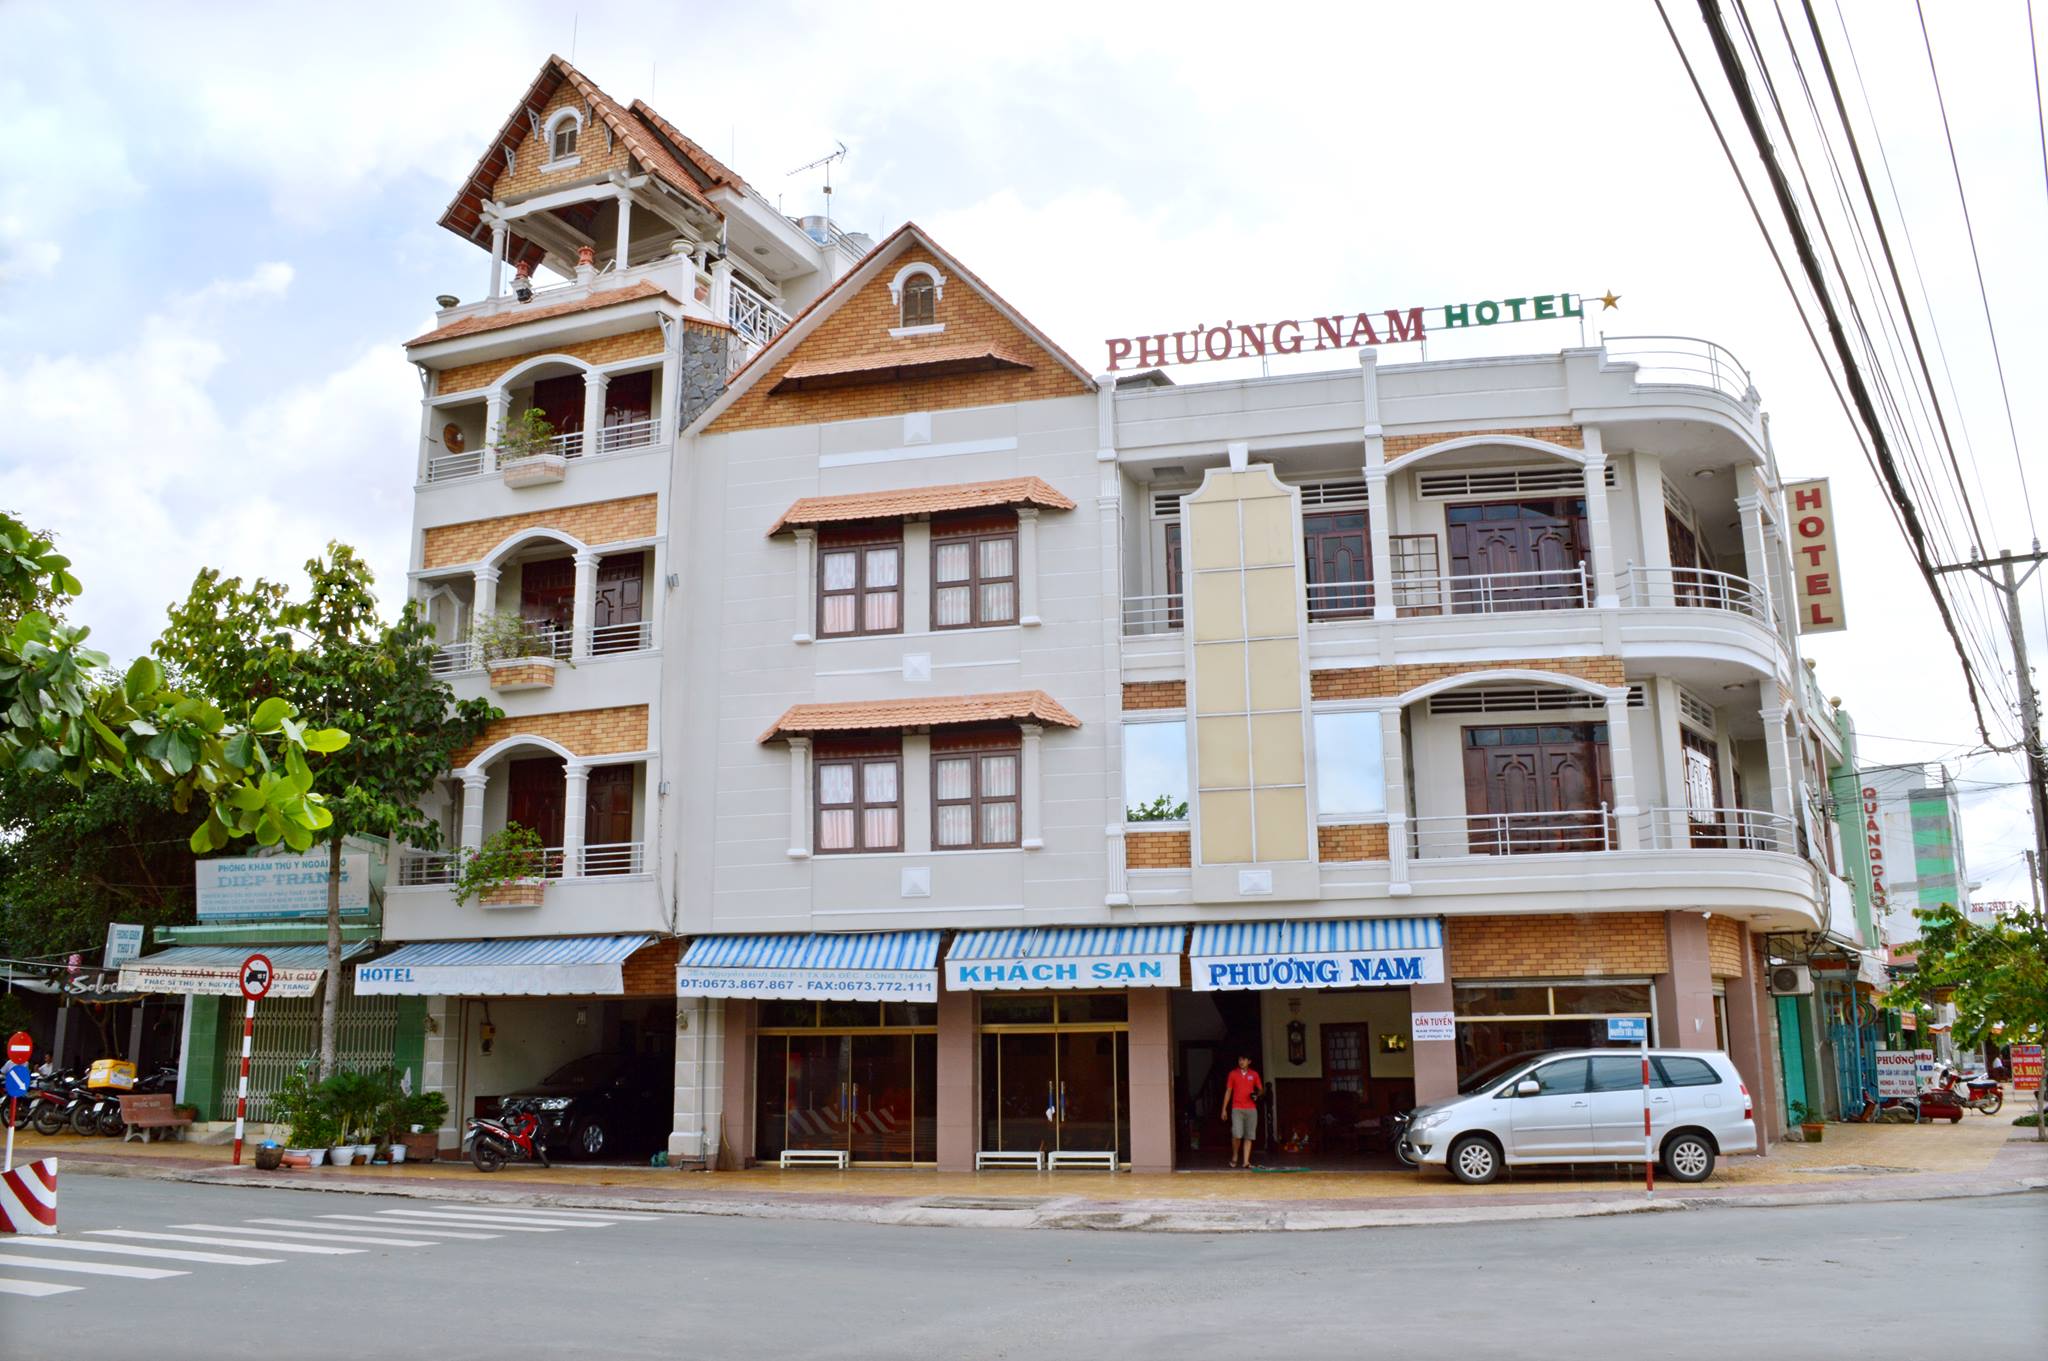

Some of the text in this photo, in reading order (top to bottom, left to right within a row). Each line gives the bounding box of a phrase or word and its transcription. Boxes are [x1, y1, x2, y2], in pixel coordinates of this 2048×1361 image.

[1105, 292, 1583, 371] PHƯƠNG NAM HOTEL
[1795, 487, 1833, 625] HOTEL
[359, 967, 415, 983] HOTEL
[681, 979, 794, 990] ĐT:0673.867.867
[807, 980, 932, 992] FAX:0673.772.111
[959, 957, 1163, 985] KHÁCH SẠN
[1208, 956, 1426, 987] PHƯƠNG NAM
